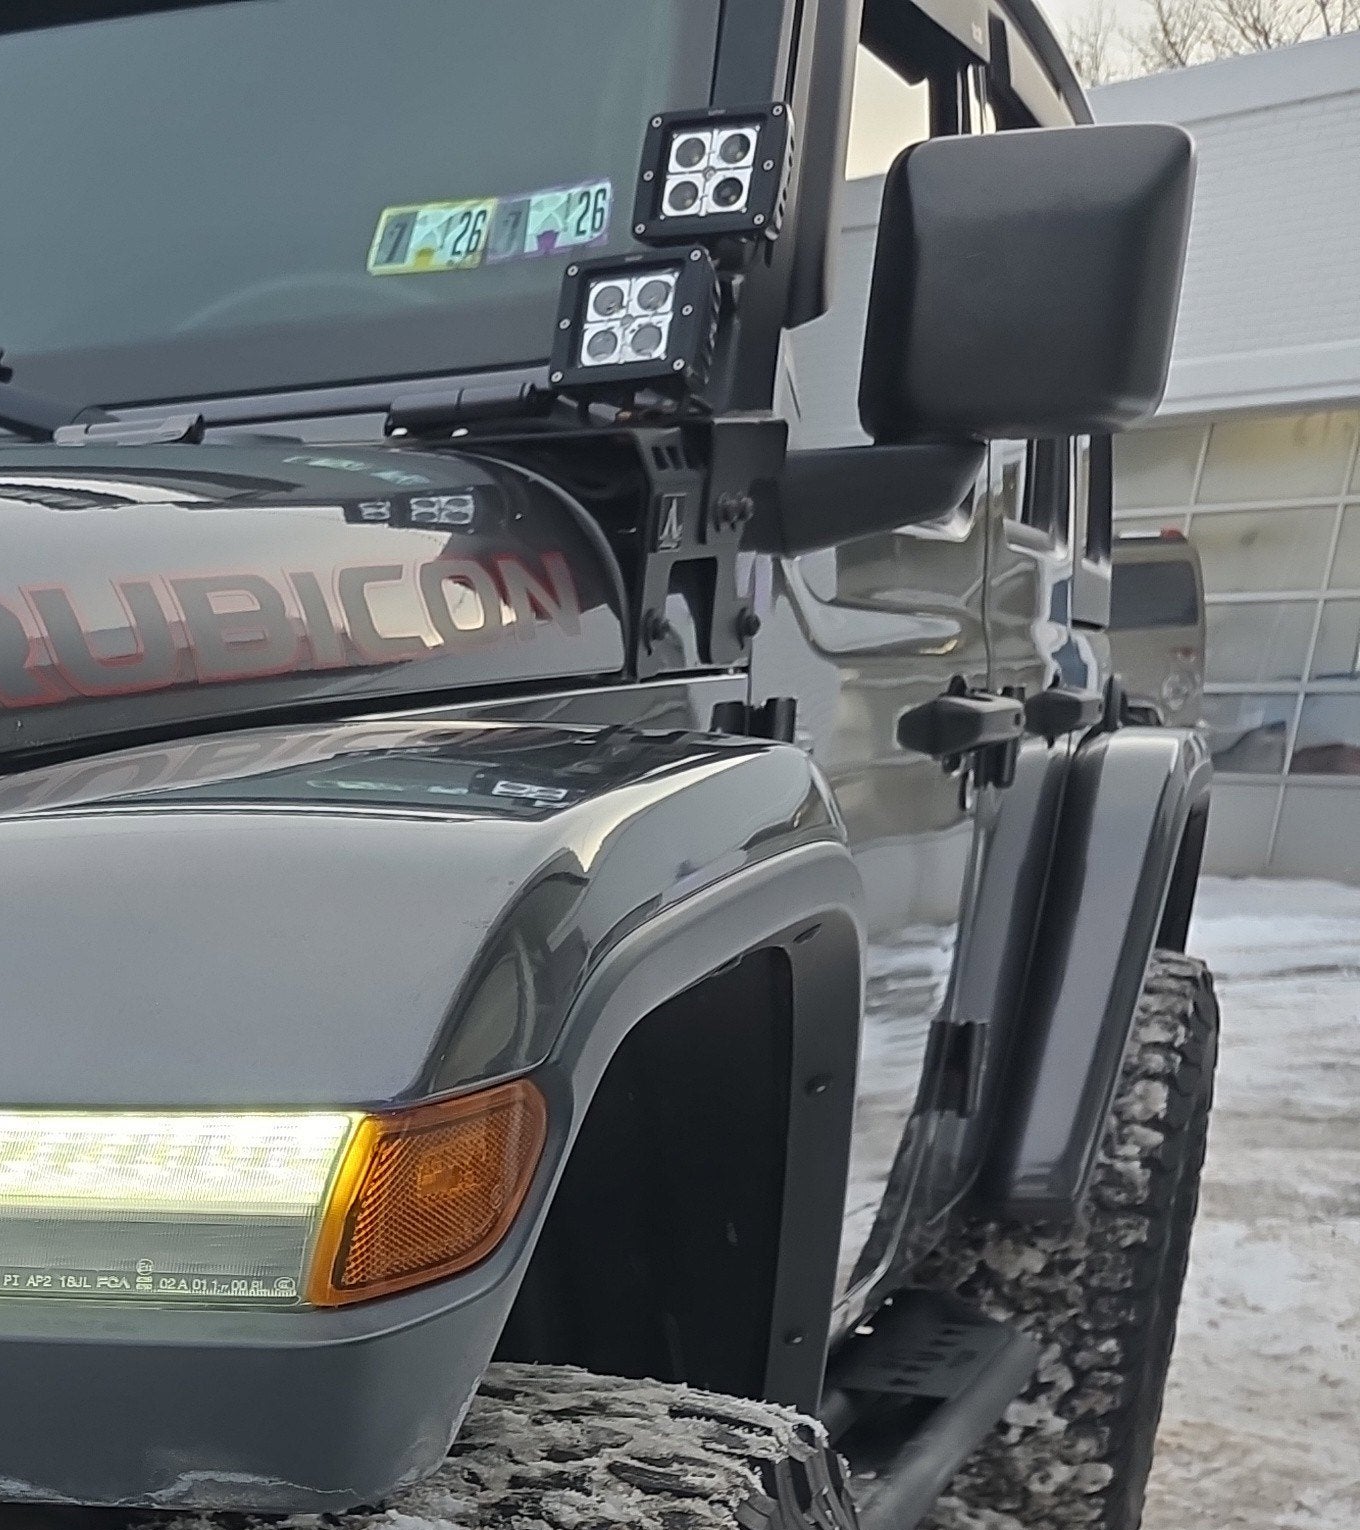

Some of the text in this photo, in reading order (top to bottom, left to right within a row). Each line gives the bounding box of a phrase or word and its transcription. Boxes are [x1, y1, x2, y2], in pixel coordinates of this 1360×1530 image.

[451, 209, 487, 256] 26
[575, 188, 607, 237] 26
[25, 1275, 53, 1288] AP2
